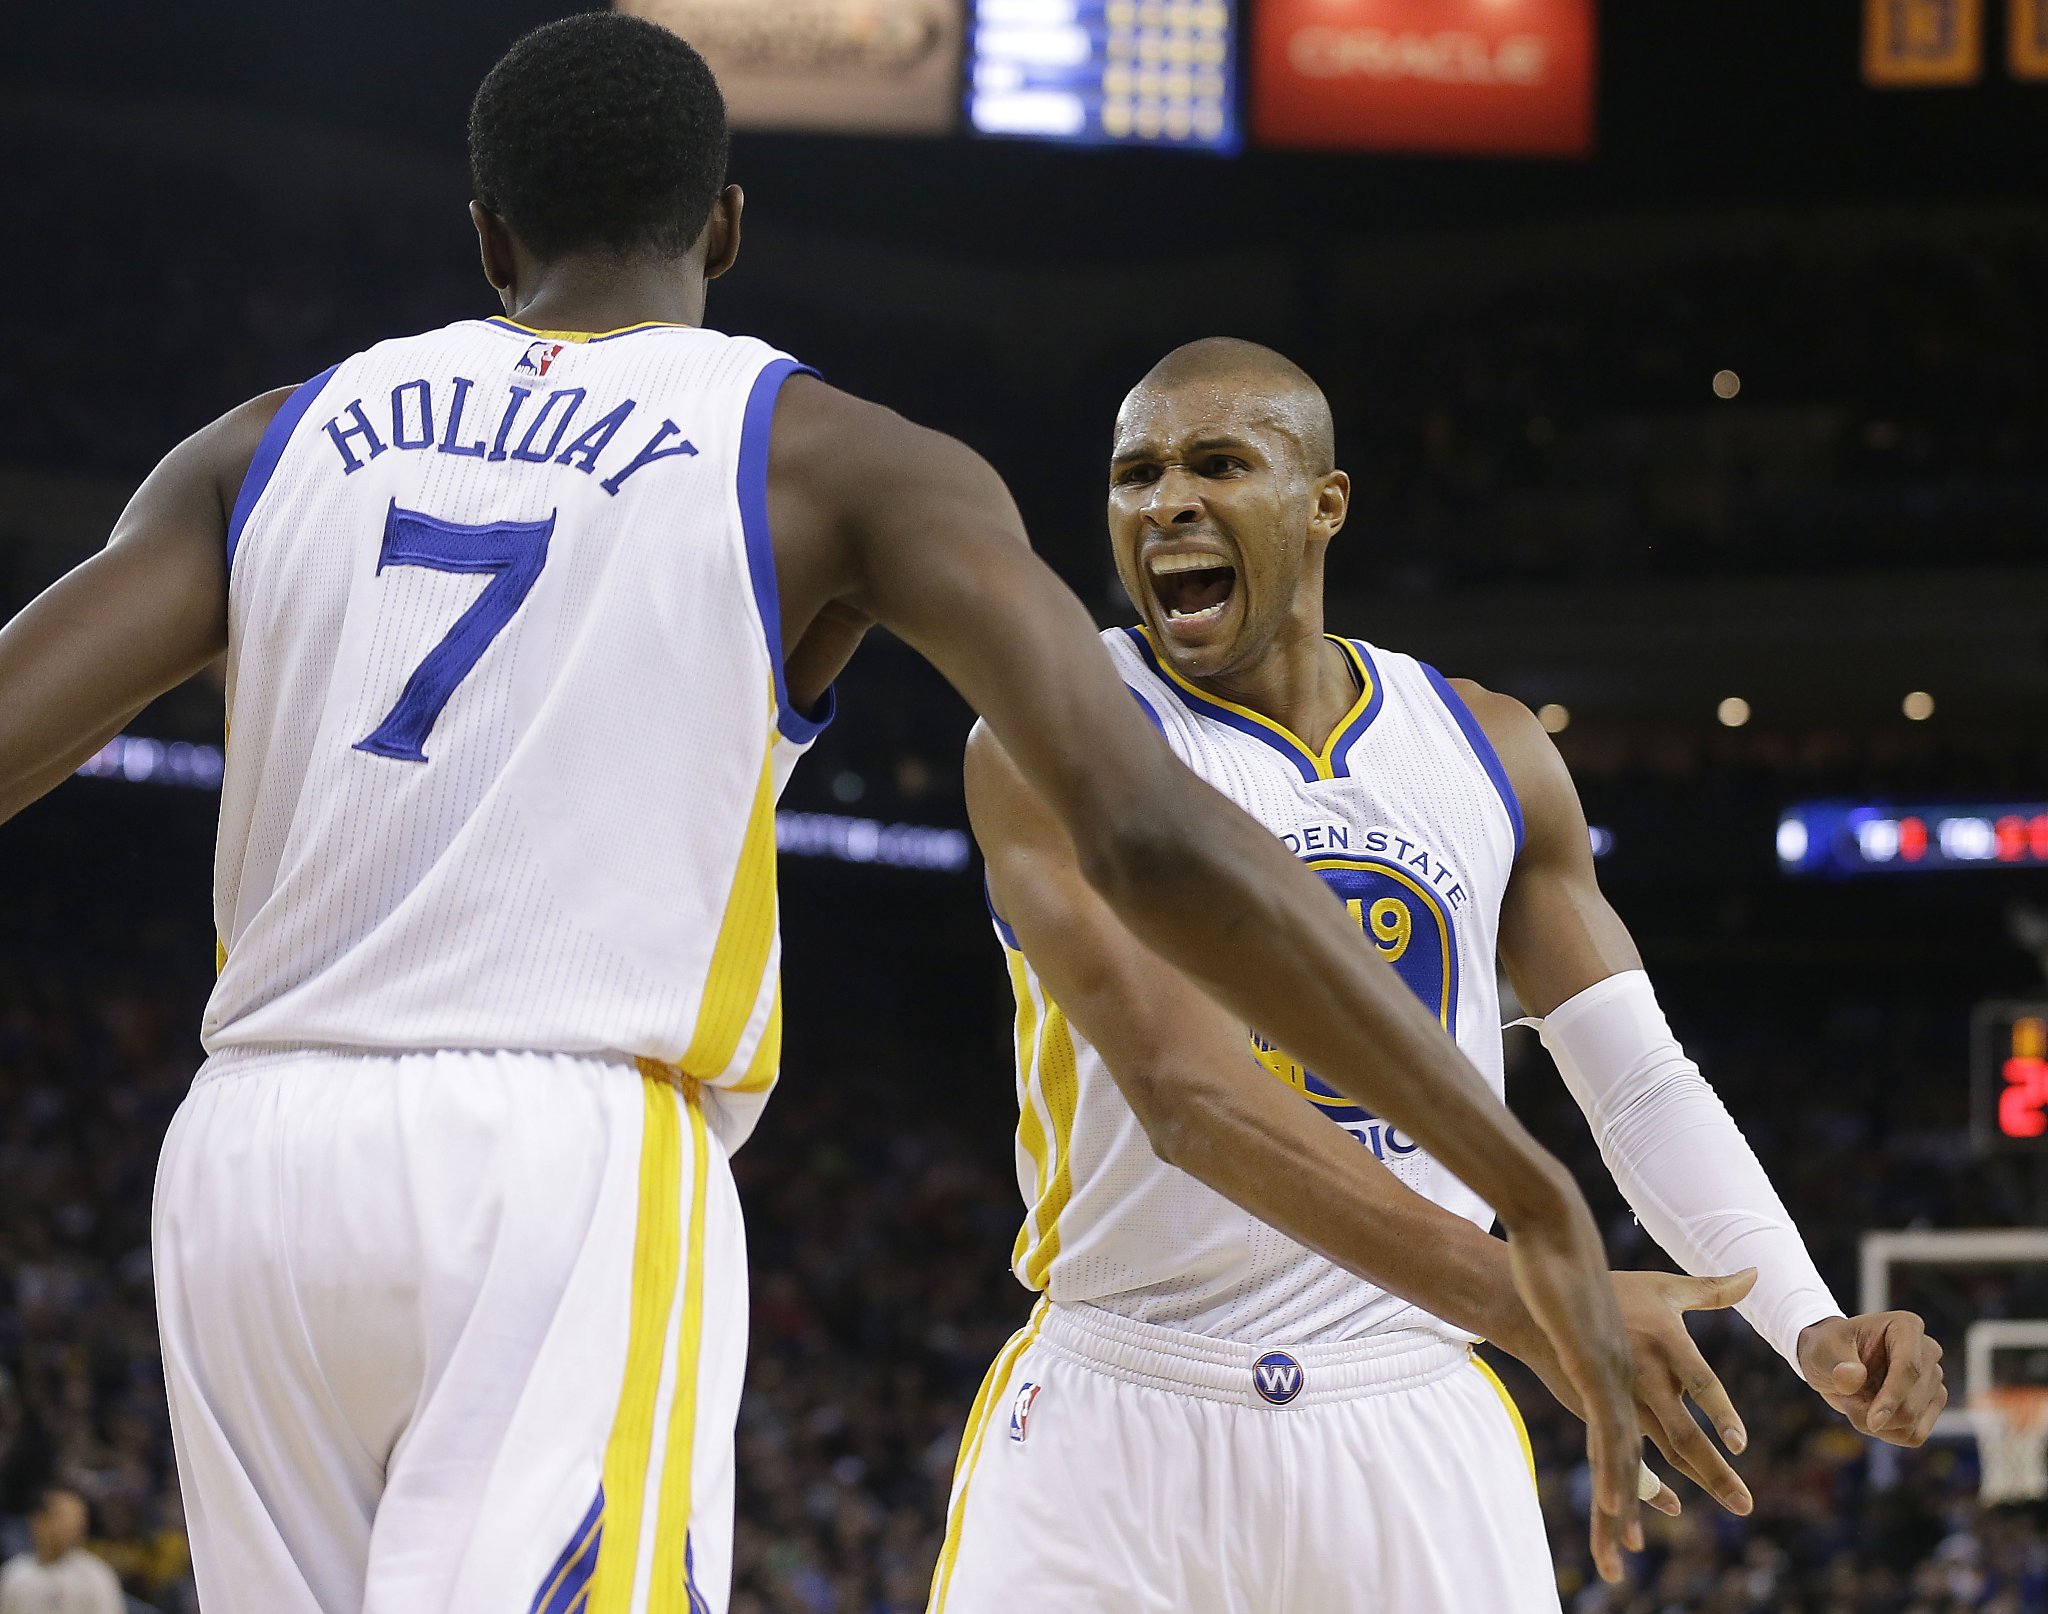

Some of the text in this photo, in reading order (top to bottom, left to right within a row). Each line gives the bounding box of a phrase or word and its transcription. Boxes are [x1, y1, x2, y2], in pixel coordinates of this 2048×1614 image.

[321, 377, 699, 496] HOLIDAY
[351, 497, 557, 763] 7
[1365, 831, 1467, 911] STATE
